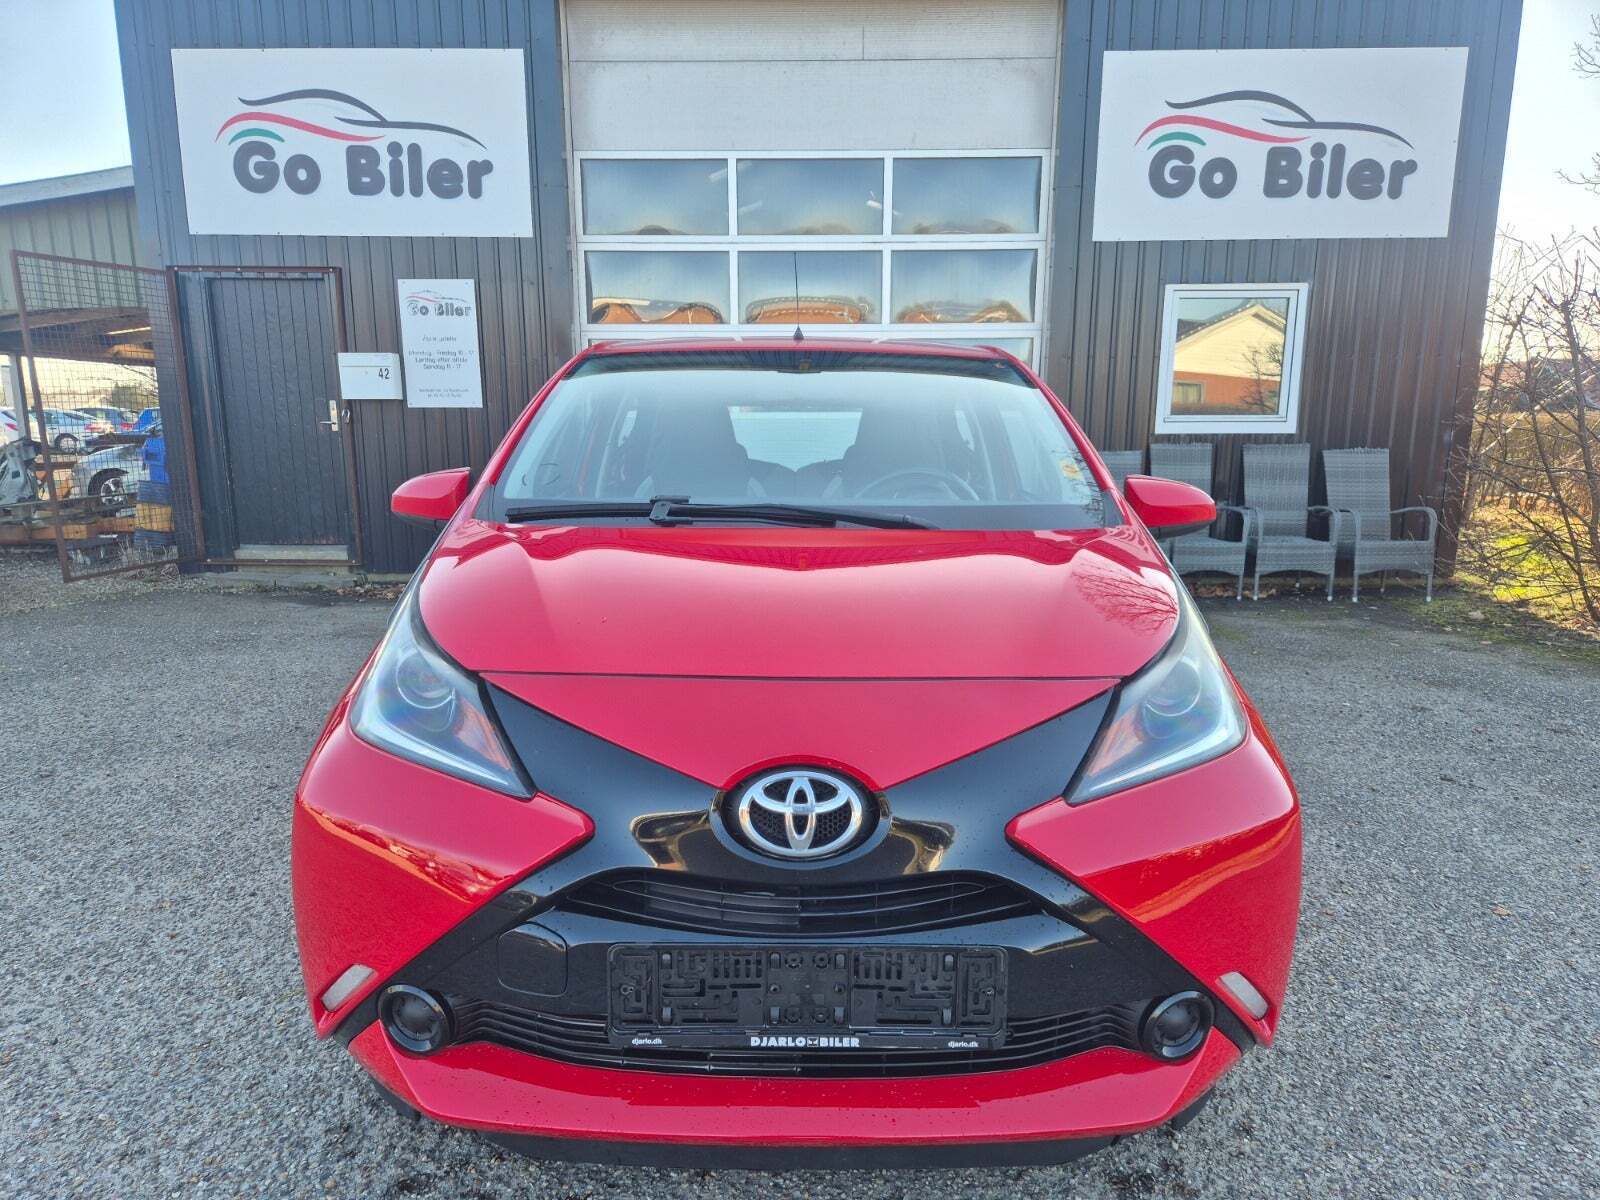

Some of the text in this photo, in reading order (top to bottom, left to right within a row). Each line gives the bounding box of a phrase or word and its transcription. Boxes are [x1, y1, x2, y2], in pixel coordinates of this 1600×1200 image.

[233, 140, 494, 199] Go Biler
[1148, 142, 1418, 200] Go Biler
[407, 302, 472, 316] Go Biler
[378, 368, 390, 380] 42
[750, 1036, 861, 1048] DJARLO BILER
